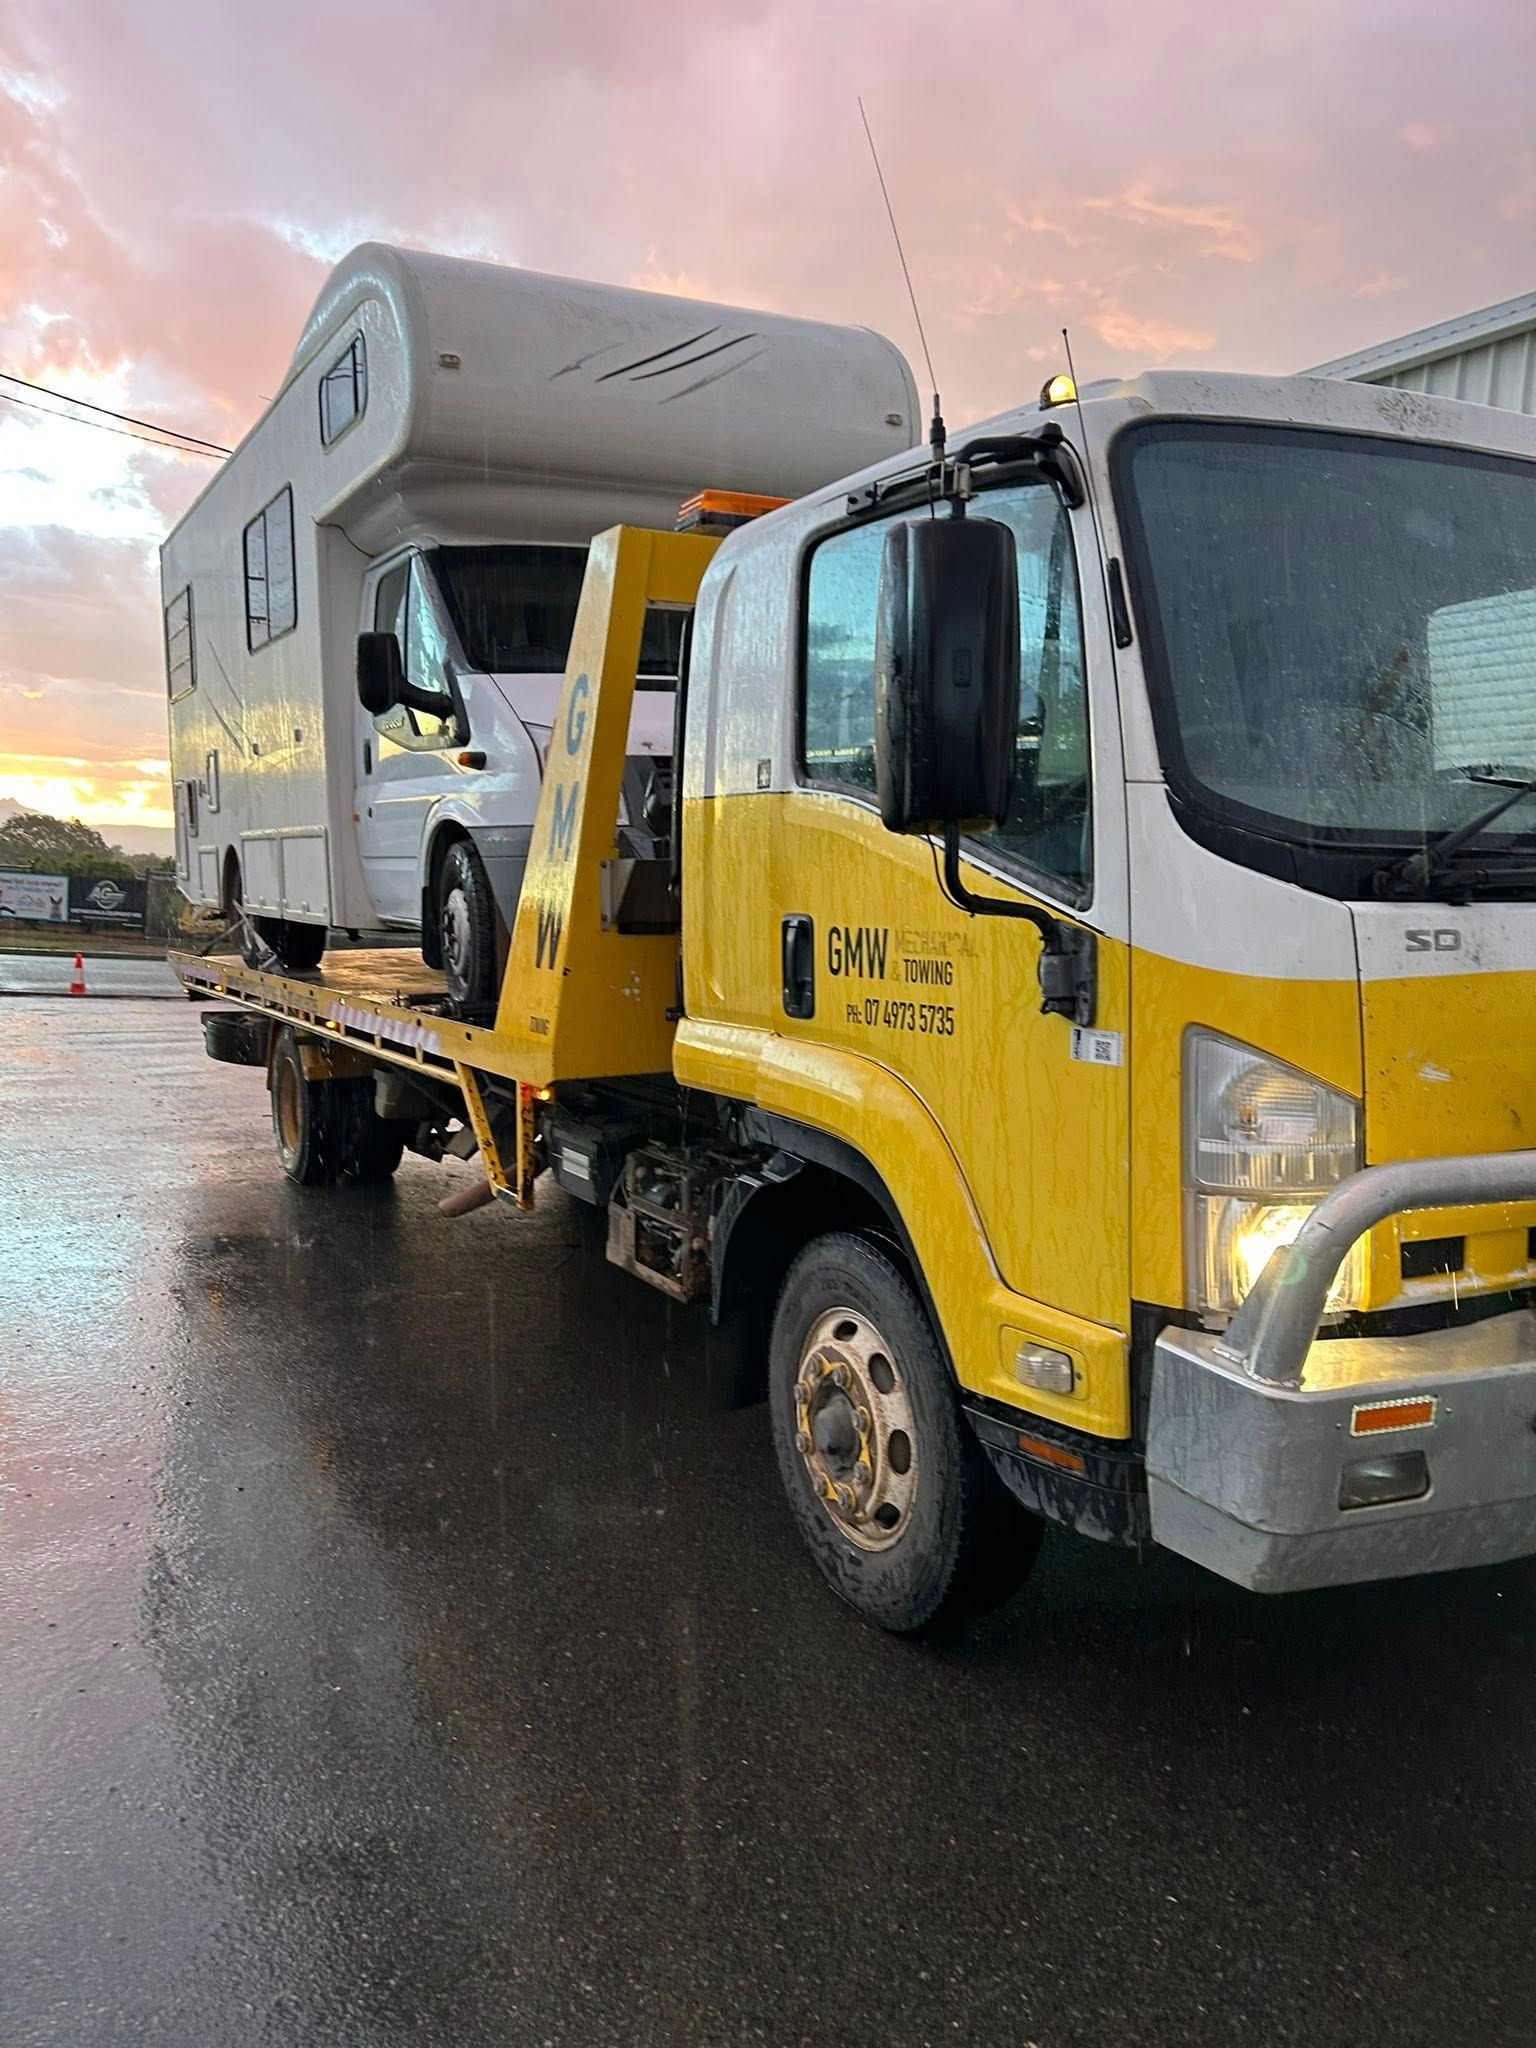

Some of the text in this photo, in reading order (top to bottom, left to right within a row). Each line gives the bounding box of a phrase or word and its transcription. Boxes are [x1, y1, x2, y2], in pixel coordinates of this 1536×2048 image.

[828, 926, 889, 980] GMW
[903, 958, 953, 986] TOWING
[846, 998, 955, 1036] PH: 07 4973 5735
